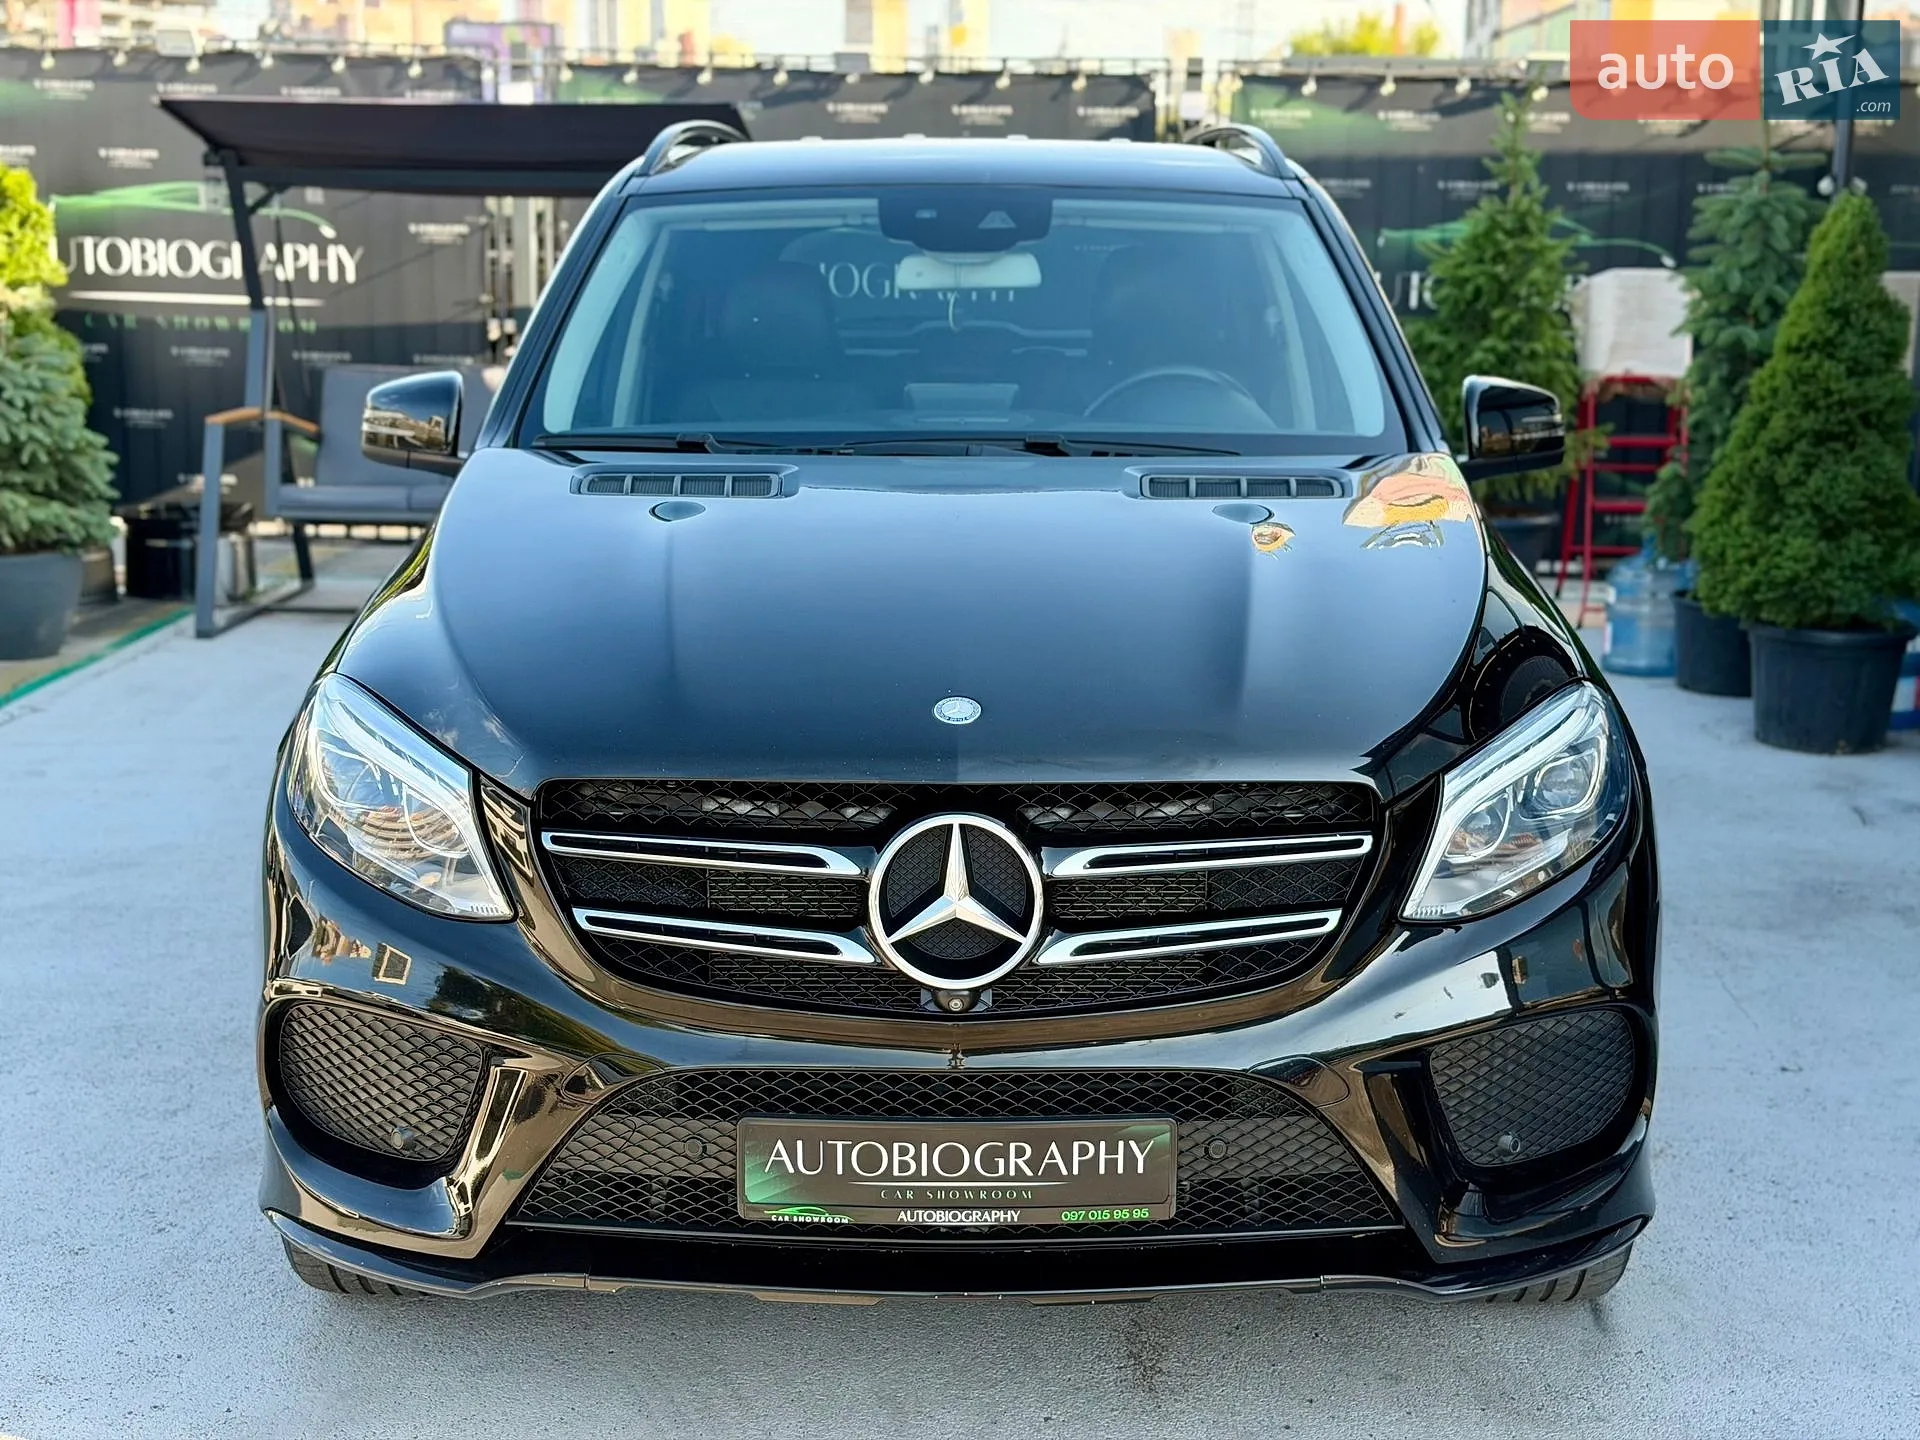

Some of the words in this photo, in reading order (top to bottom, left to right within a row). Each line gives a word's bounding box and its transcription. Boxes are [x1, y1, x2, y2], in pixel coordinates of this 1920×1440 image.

[764, 1139, 1154, 1177] AUTOBIOGRAPHY
[881, 1189, 914, 1199] CAR
[927, 1189, 1033, 1200] SHOWROOM
[793, 1215, 849, 1224] SHOWROOM
[897, 1210, 1021, 1223] AUTOBIOGRAPHY
[1061, 1211, 1085, 1221] 097
[1088, 1210, 1110, 1220] 015
[1113, 1209, 1130, 1219] 95
[1132, 1208, 1149, 1218] 95
